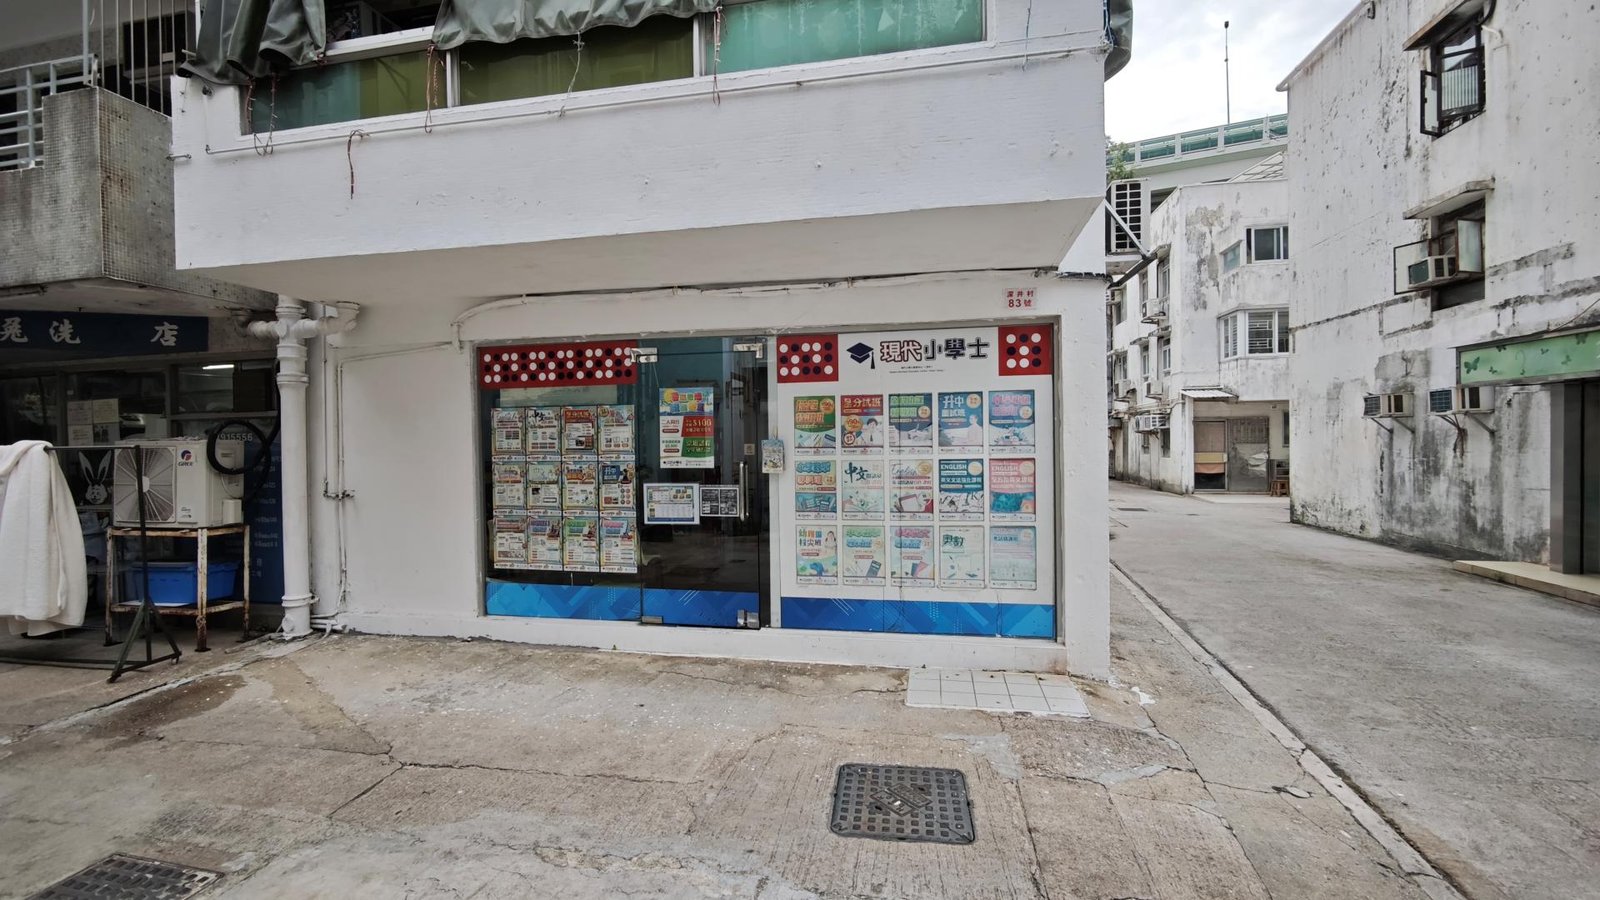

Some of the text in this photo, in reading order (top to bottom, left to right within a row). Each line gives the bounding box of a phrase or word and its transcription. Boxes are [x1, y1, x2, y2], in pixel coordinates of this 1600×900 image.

[880, 337, 989, 363] 現代小學士
[844, 461, 869, 483] 中文
